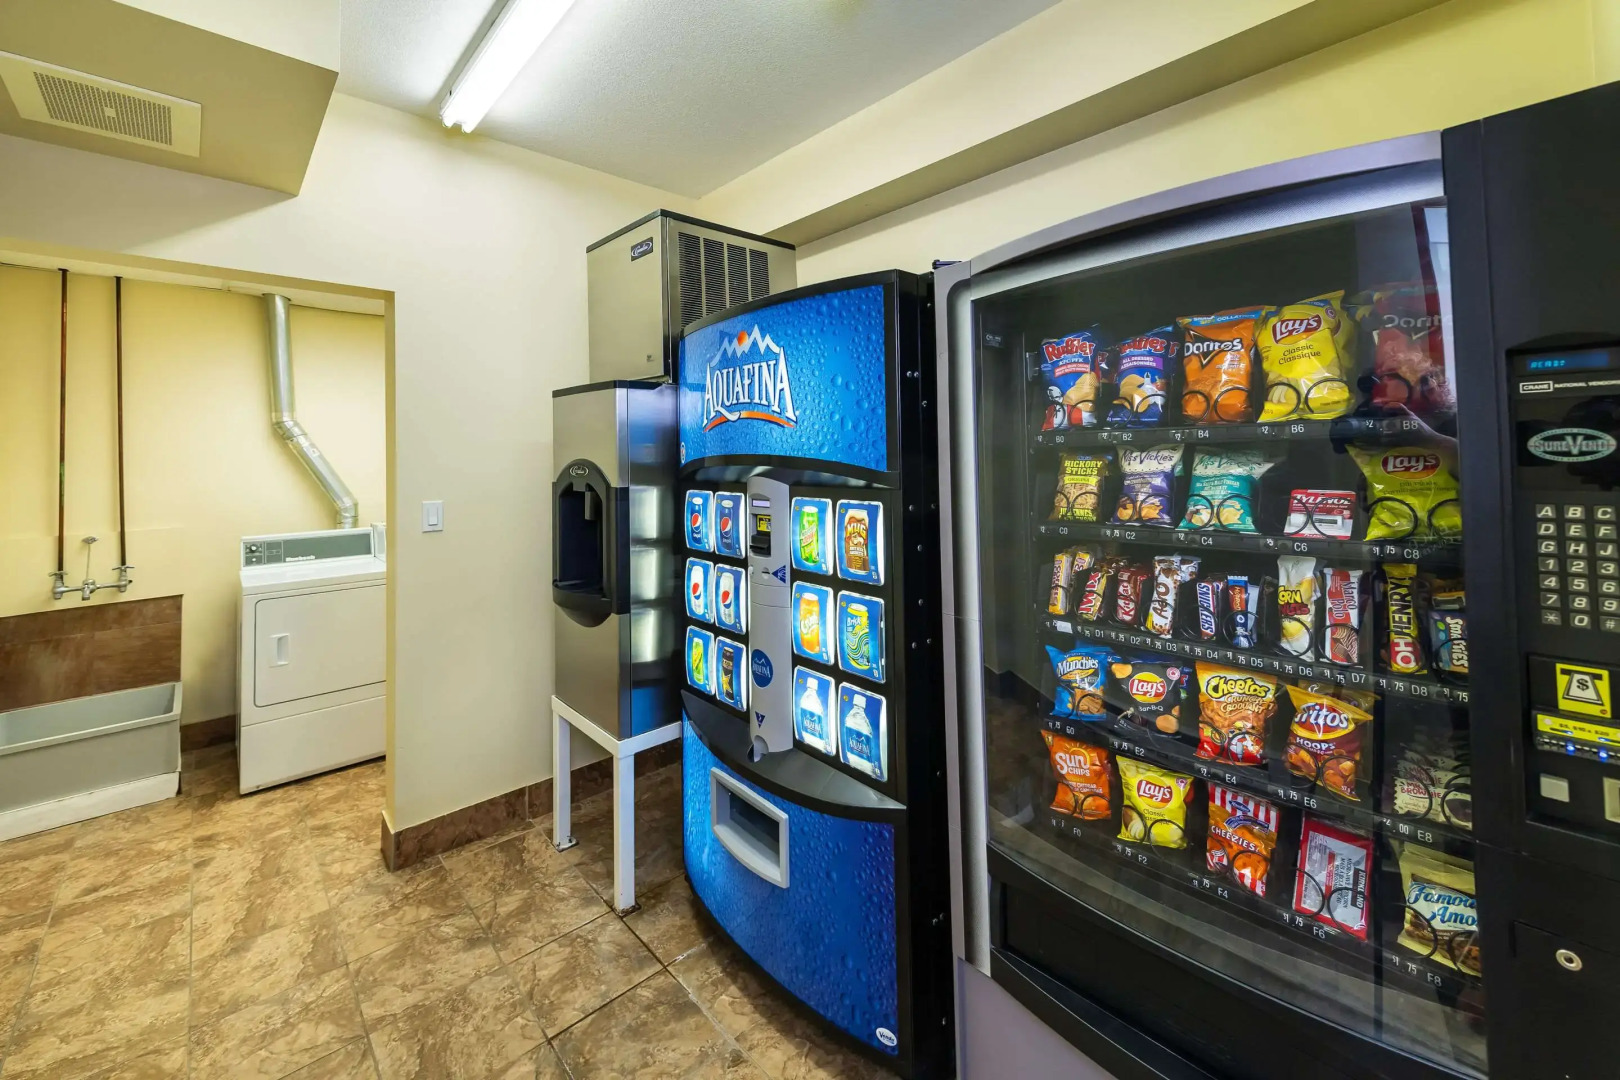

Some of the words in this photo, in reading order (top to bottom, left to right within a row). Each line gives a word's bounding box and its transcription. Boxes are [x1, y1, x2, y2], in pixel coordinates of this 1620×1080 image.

[1274, 314, 1322, 340] Lay's
[1184, 338, 1242, 357] Doritos
[1283, 343, 1314, 357] Classic
[1278, 349, 1321, 365] Classique
[702, 346, 798, 427] AQUAFINA
[1523, 383, 1549, 391] CRANE
[1291, 424, 1305, 433] B6
[1401, 420, 1418, 430] B8
[1122, 433, 1133, 441] B2
[1198, 430, 1209, 438] B4
[1064, 460, 1102, 468] HICKORY
[1065, 467, 1098, 475] STICKS
[1540, 506, 1553, 516] A
[1568, 507, 1582, 517] B
[1597, 508, 1612, 519] C
[847, 522, 866, 539] MUG
[1059, 527, 1068, 535] C0
[1125, 531, 1136, 540] C2
[1540, 523, 1554, 534] D
[1569, 525, 1582, 535] E
[1598, 526, 1612, 536] F
[1201, 536, 1213, 545] C4
[1294, 541, 1308, 552] C6
[1403, 547, 1420, 560] C8
[1541, 541, 1555, 552] G
[1569, 543, 1584, 554] H
[1600, 544, 1613, 555] J
[1546, 559, 1554, 569] 1
[1571, 561, 1584, 572] 2
[1601, 563, 1615, 574] 3
[1544, 577, 1556, 587] 4
[1572, 579, 1585, 590] 5
[1602, 582, 1616, 592] 6
[1078, 571, 1102, 614] TWIX
[1278, 585, 1303, 605] CORN
[1343, 581, 1358, 610] Marco
[1151, 582, 1170, 620] Aero
[1546, 594, 1558, 604] 7
[1573, 597, 1587, 608] 8
[1603, 600, 1617, 611] 9
[1330, 598, 1349, 618] Polo
[1574, 615, 1588, 626] 0
[1095, 629, 1104, 638] D1
[1130, 635, 1141, 644] D2
[1166, 642, 1177, 652] D3
[1393, 637, 1417, 668] OH
[1206, 649, 1218, 660] D4
[1057, 655, 1099, 678] Munchies
[1250, 657, 1264, 668] D5
[1299, 666, 1313, 677] D6
[1352, 672, 1366, 684] D7
[1132, 679, 1164, 698] Lay's
[1206, 675, 1271, 700] Cheetos
[1411, 684, 1428, 697] D8
[1220, 702, 1264, 714] CROQUANT
[1294, 702, 1349, 729] Fritos
[1296, 737, 1335, 751] HOOPS
[1135, 746, 1145, 757] E2
[1055, 752, 1090, 775] Sun
[1068, 767, 1091, 777] CHIPS
[1225, 773, 1237, 785] E4
[1138, 780, 1171, 802] Lay's
[1304, 796, 1317, 809] E6
[1073, 827, 1082, 837] F0
[1417, 829, 1433, 843] E8
[1138, 854, 1148, 865] F2
[1217, 887, 1229, 899] F4
[1356, 869, 1367, 908] KIRKLND
[1312, 926, 1326, 940] F6
[1427, 971, 1443, 988] F8
